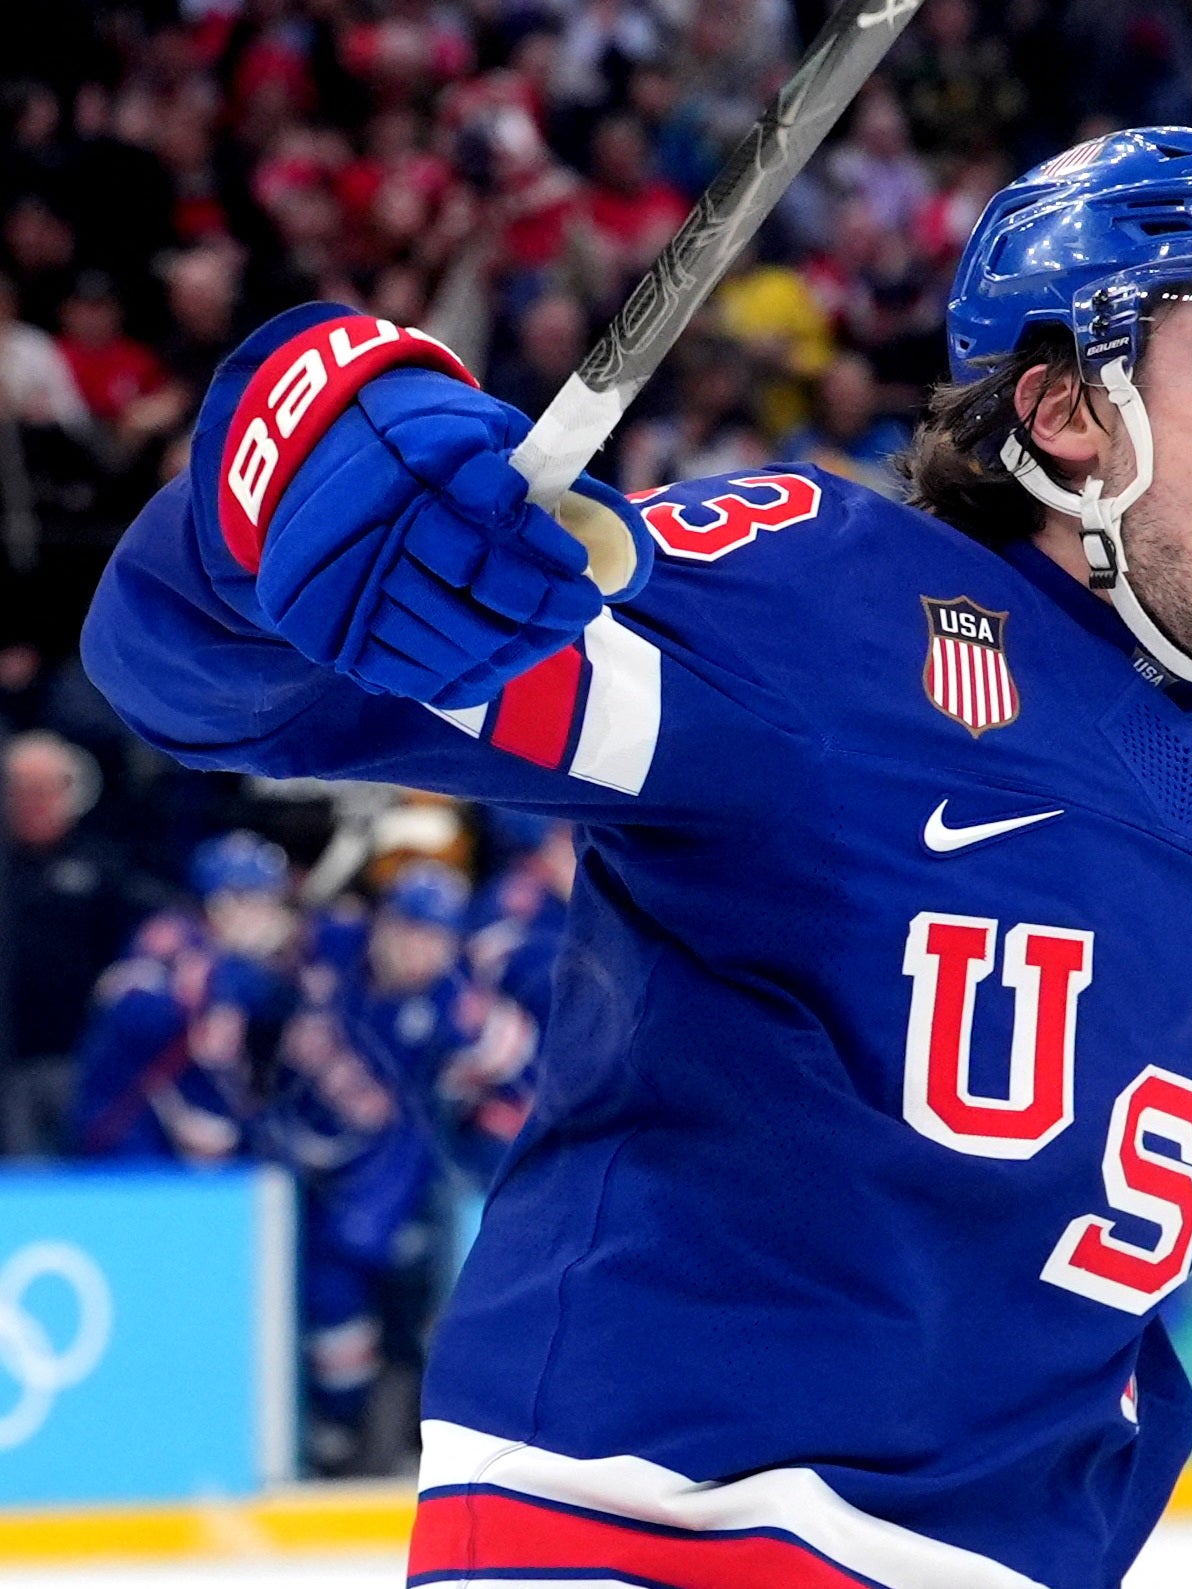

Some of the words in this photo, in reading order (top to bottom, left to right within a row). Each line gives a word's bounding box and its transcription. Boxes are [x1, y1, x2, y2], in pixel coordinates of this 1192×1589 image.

[1086, 336, 1130, 357] BAUER
[228, 319, 480, 526] BAU
[625, 474, 822, 562] 3
[939, 608, 994, 643] USA
[1133, 657, 1165, 688] USA
